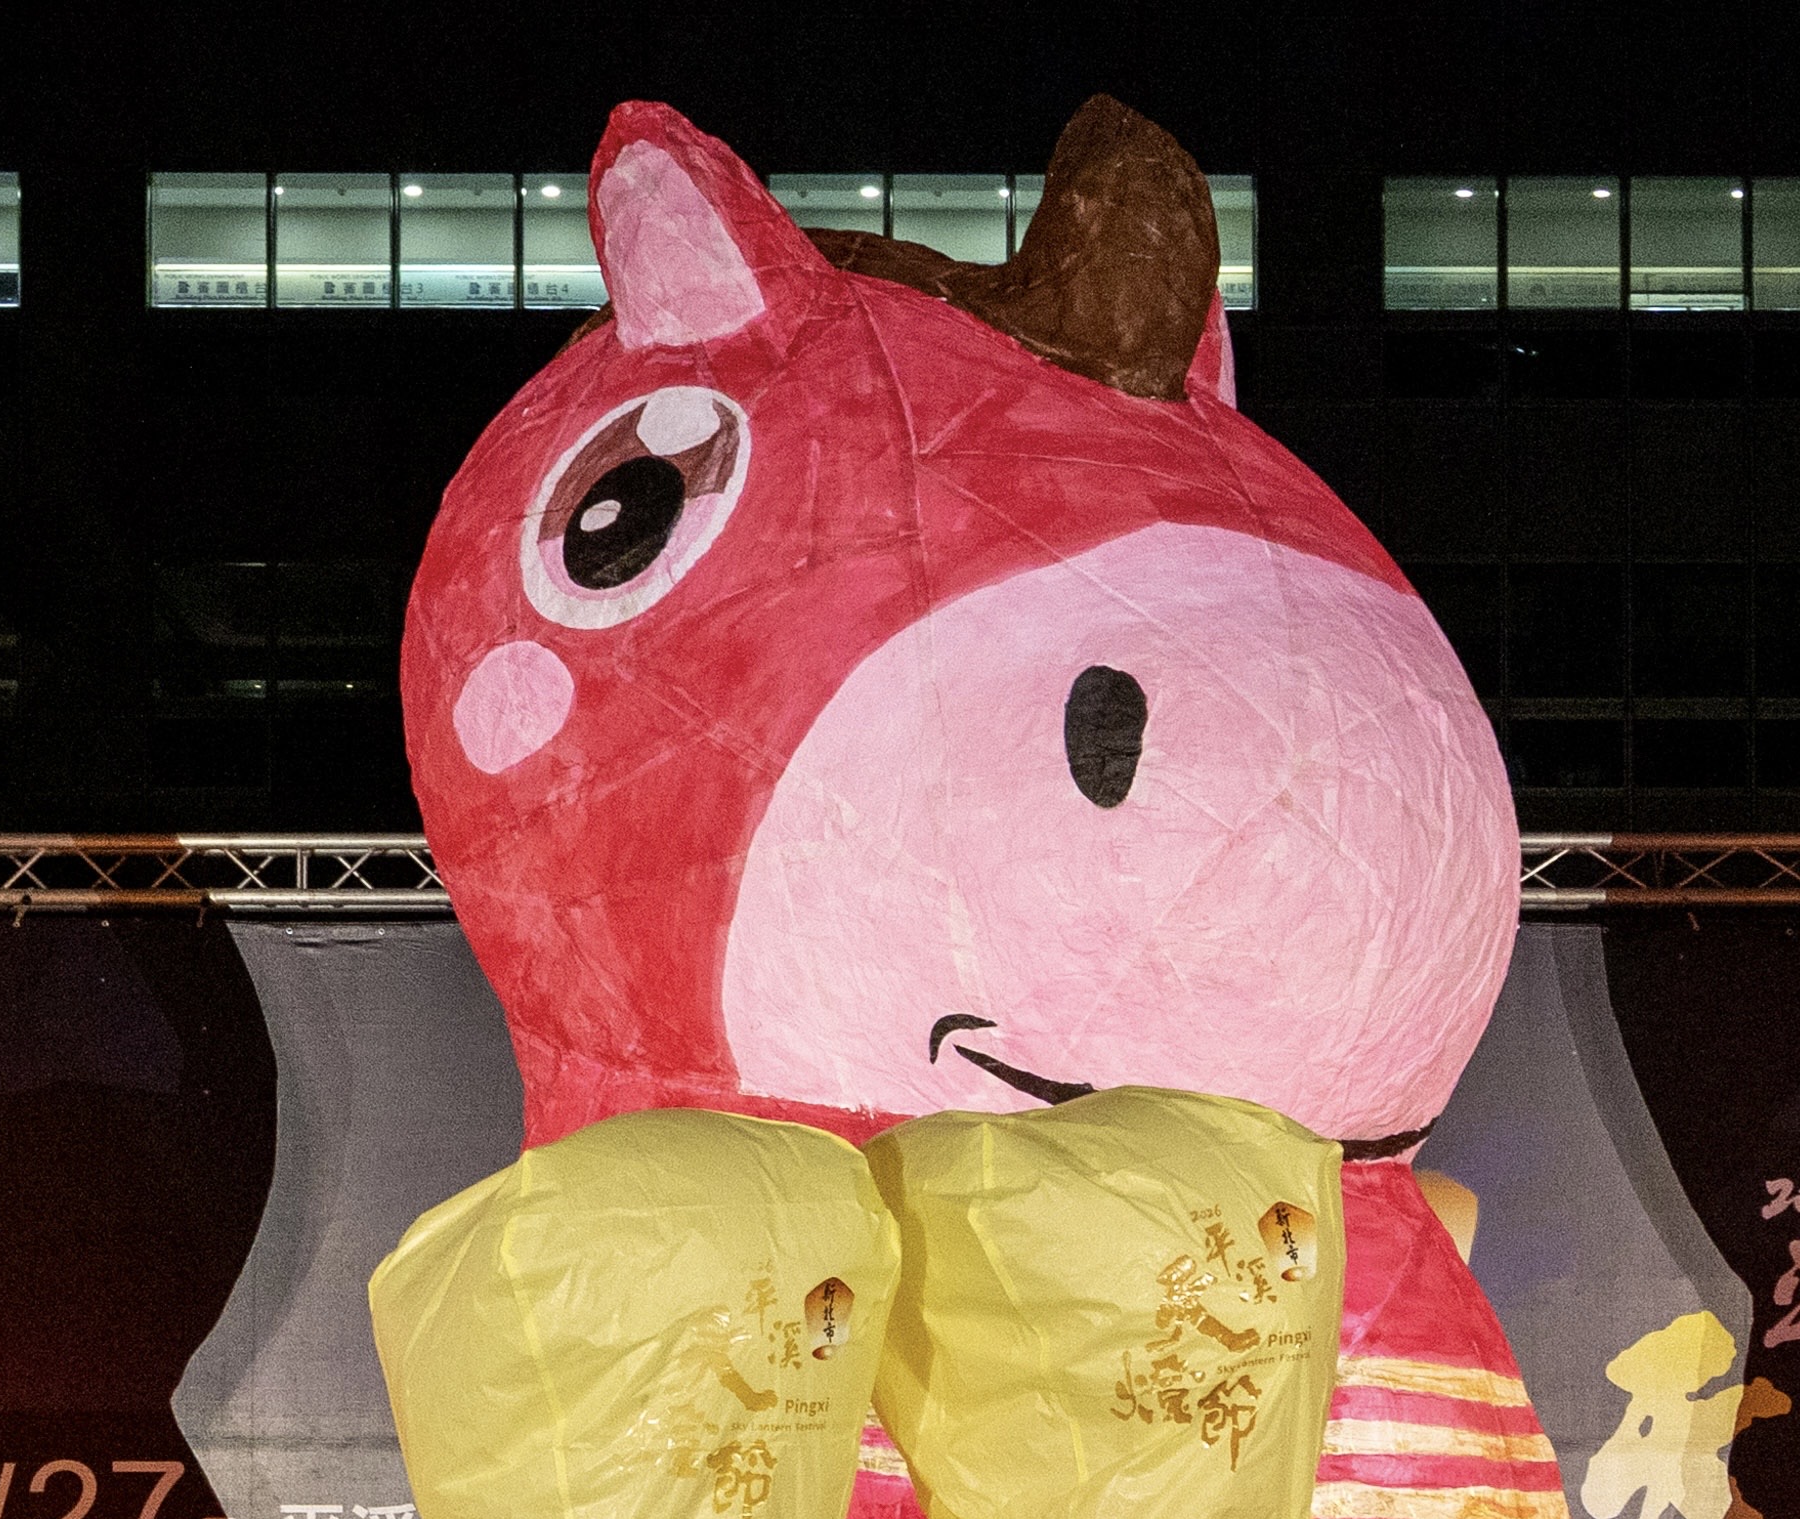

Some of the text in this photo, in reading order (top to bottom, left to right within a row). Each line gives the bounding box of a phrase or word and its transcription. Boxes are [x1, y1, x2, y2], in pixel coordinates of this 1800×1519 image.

[1190, 1204, 1222, 1224] 2026
[1274, 1208, 1299, 1266] 新北市
[822, 1283, 837, 1344] 新北市
[1268, 1326, 1312, 1348] Pingxi
[785, 1397, 830, 1418] Pingxi
